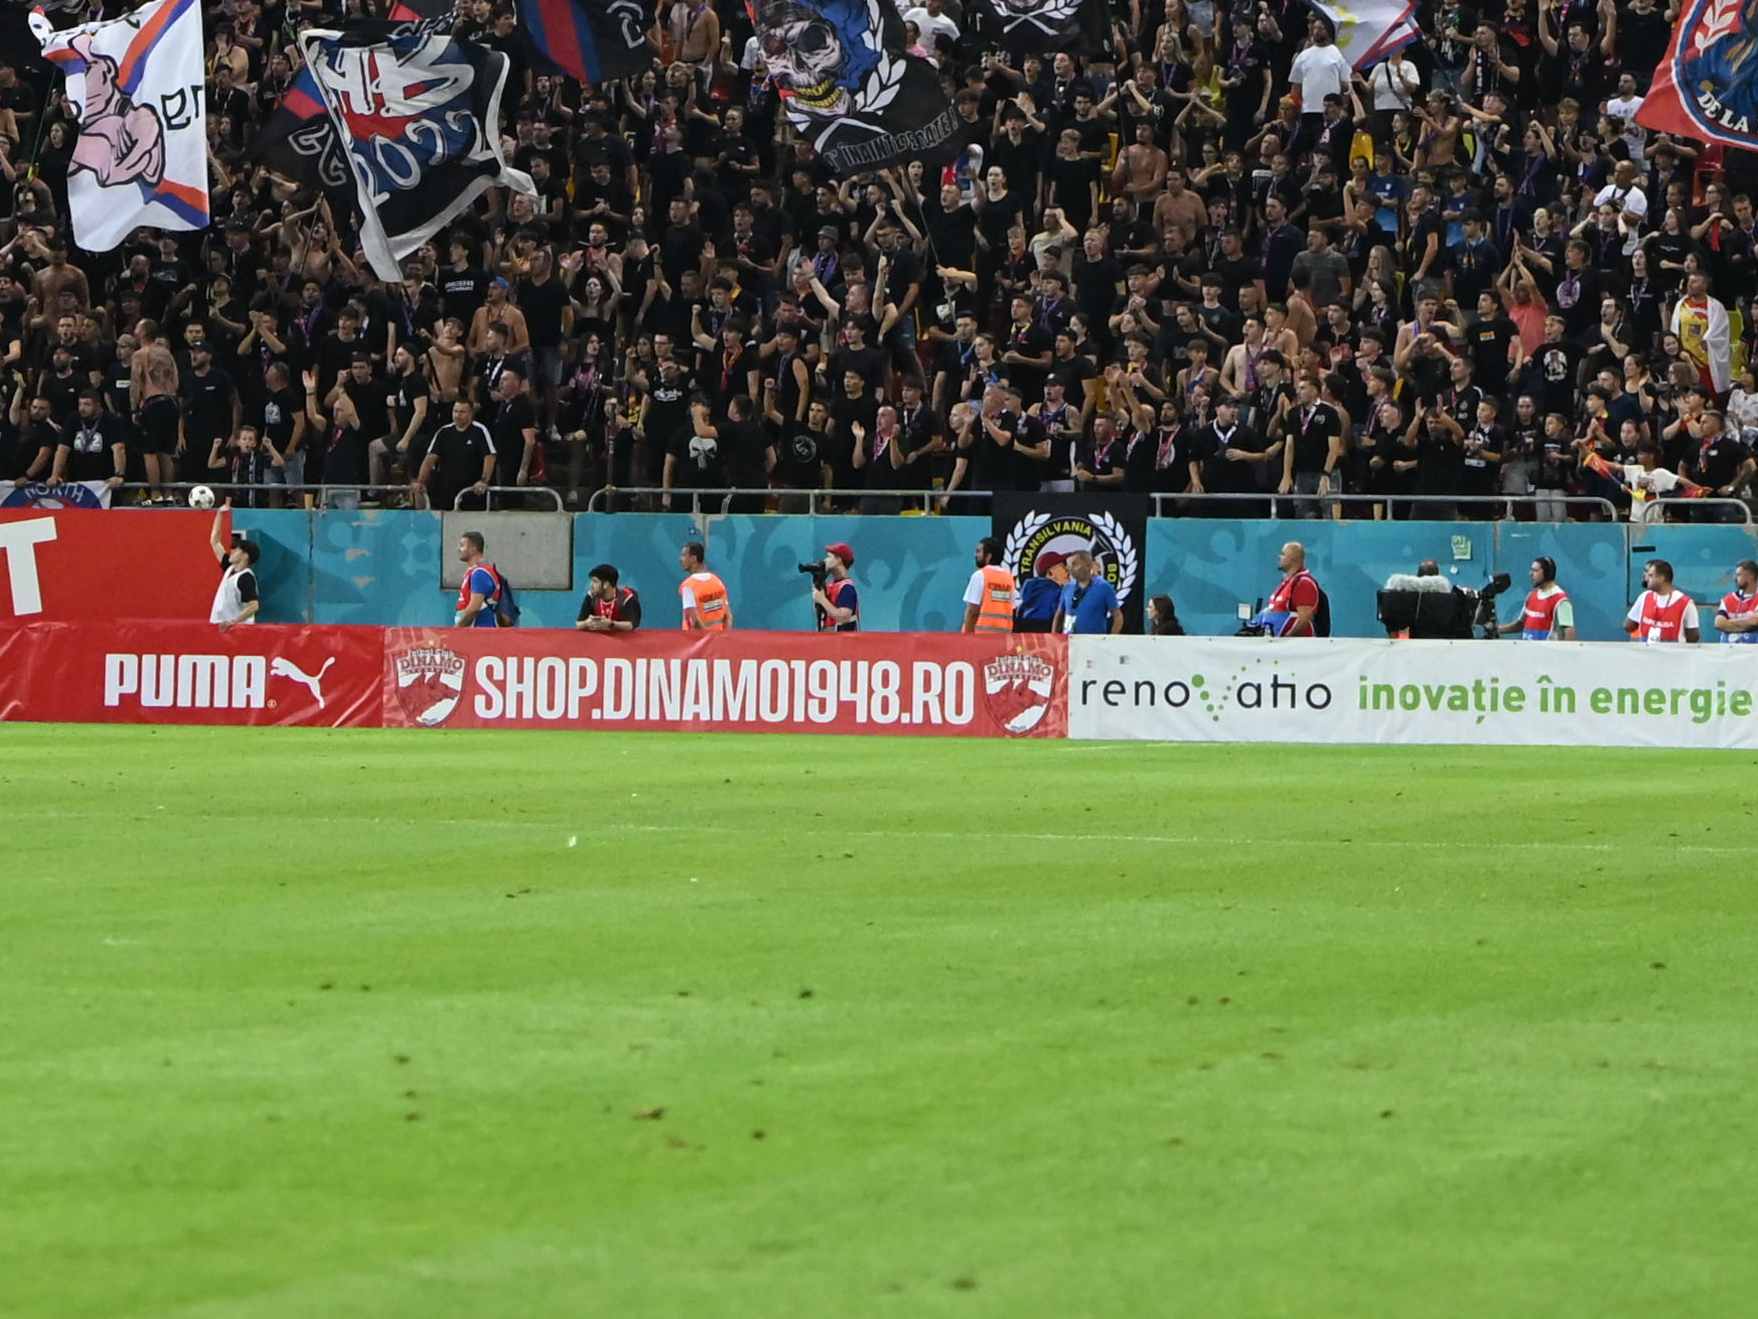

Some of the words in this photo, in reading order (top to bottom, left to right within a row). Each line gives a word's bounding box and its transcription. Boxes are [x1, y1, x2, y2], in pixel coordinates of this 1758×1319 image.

[1698, 90, 1722, 119] DE
[1719, 108, 1750, 135] LA
[1020, 520, 1093, 574] TRANSILVANIA
[104, 653, 267, 709] PUMA
[400, 653, 464, 672] DINAMO
[987, 660, 1053, 678] DINAMO
[474, 655, 975, 725] SHOP.DINAMO1948.RO
[1358, 673, 1522, 724] inovație
[1537, 675, 1576, 715] în
[1589, 676, 1753, 725] energie
